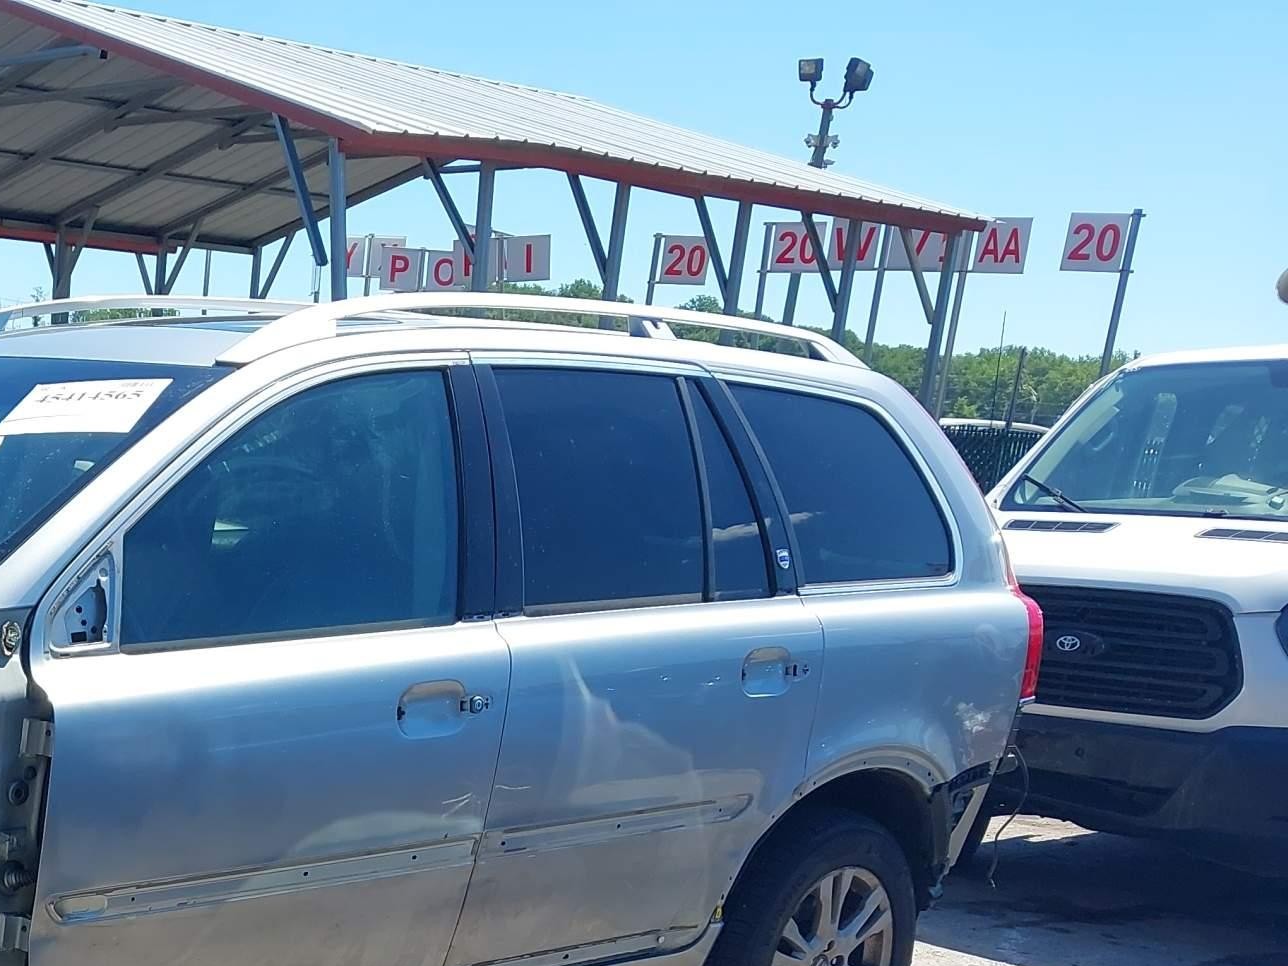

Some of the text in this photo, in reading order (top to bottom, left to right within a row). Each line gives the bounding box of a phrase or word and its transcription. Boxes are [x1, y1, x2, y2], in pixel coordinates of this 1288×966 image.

[775, 231, 816, 264] 20
[978, 227, 1020, 264] AA
[1067, 223, 1121, 262] 20
[389, 254, 410, 283] P
[664, 244, 706, 277] 20
